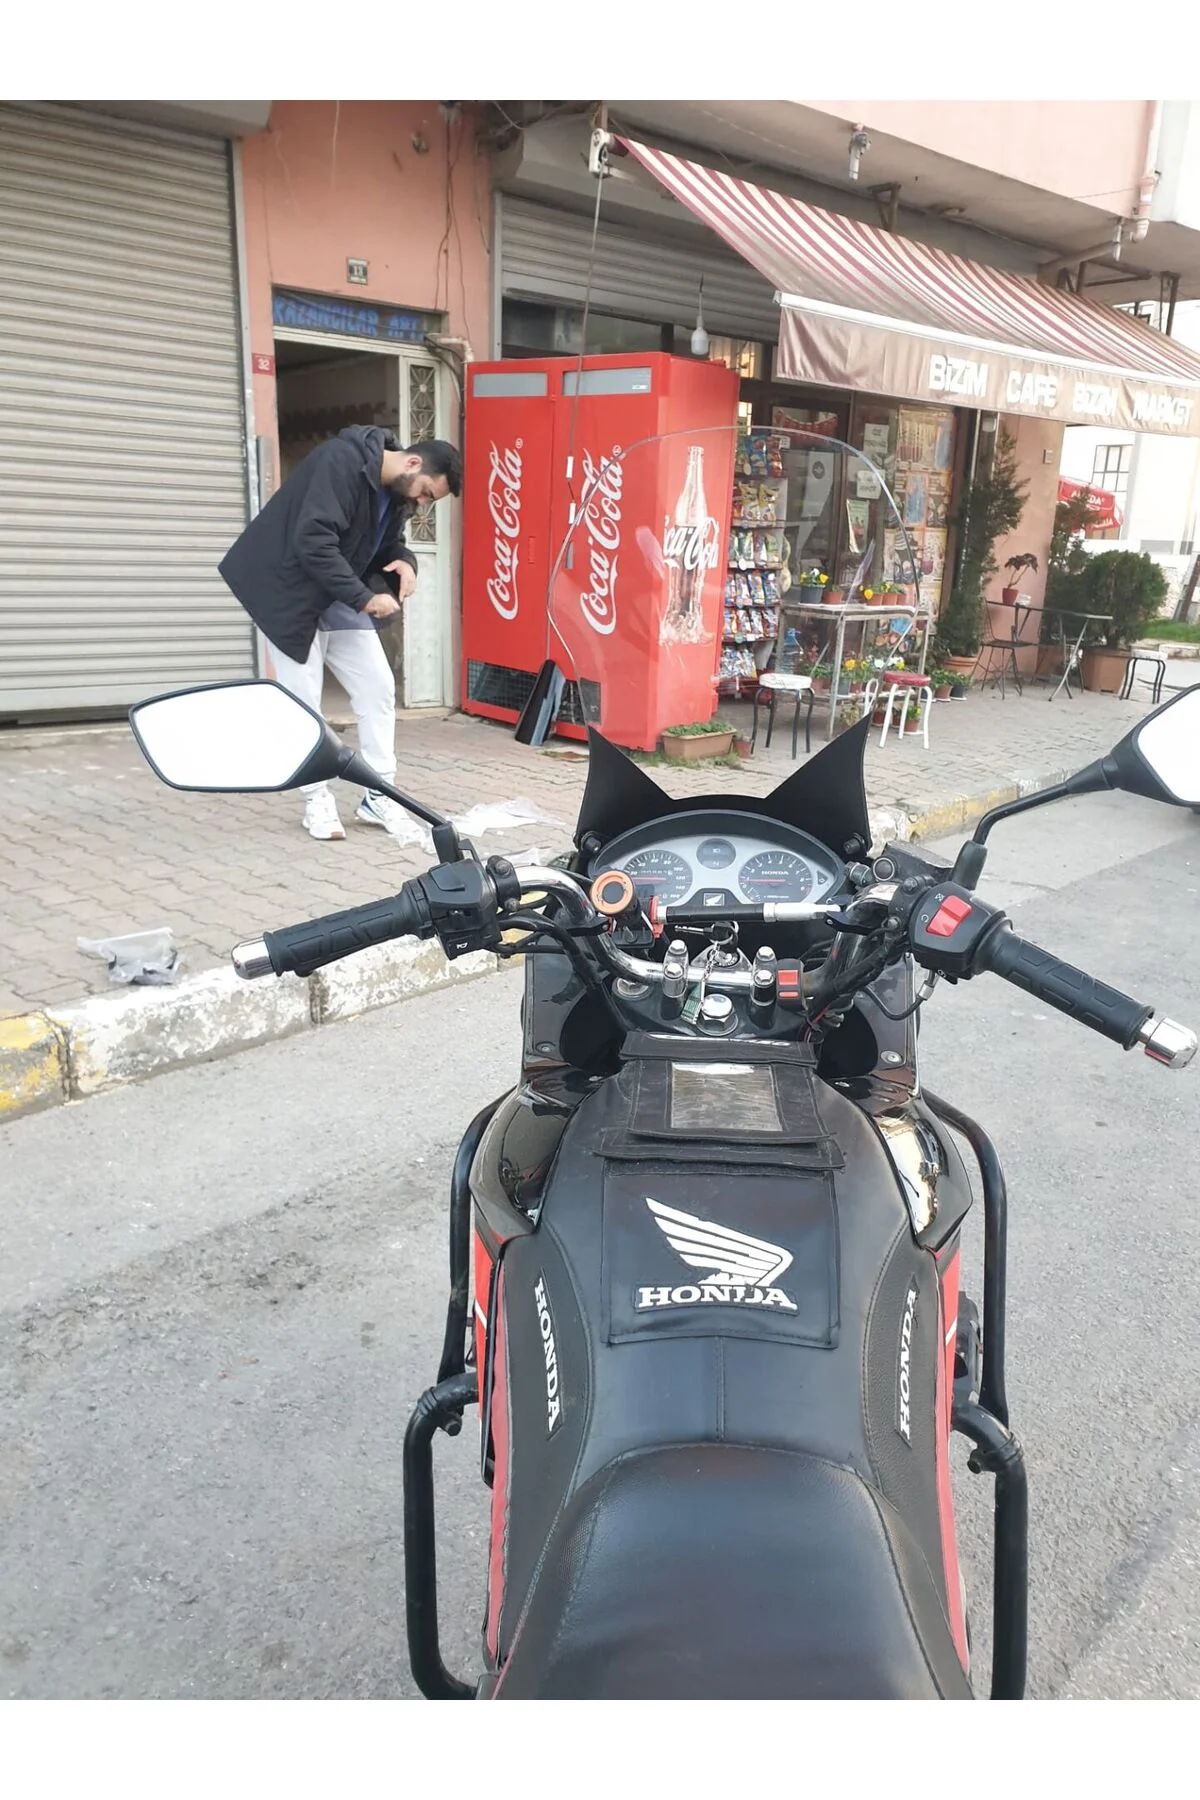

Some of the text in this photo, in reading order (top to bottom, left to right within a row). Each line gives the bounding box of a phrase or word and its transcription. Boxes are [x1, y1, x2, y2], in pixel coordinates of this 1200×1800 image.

[534, 1277, 560, 1433] HONDA
[638, 1285, 799, 1311] HONDA
[900, 1289, 917, 1441] HONDA
